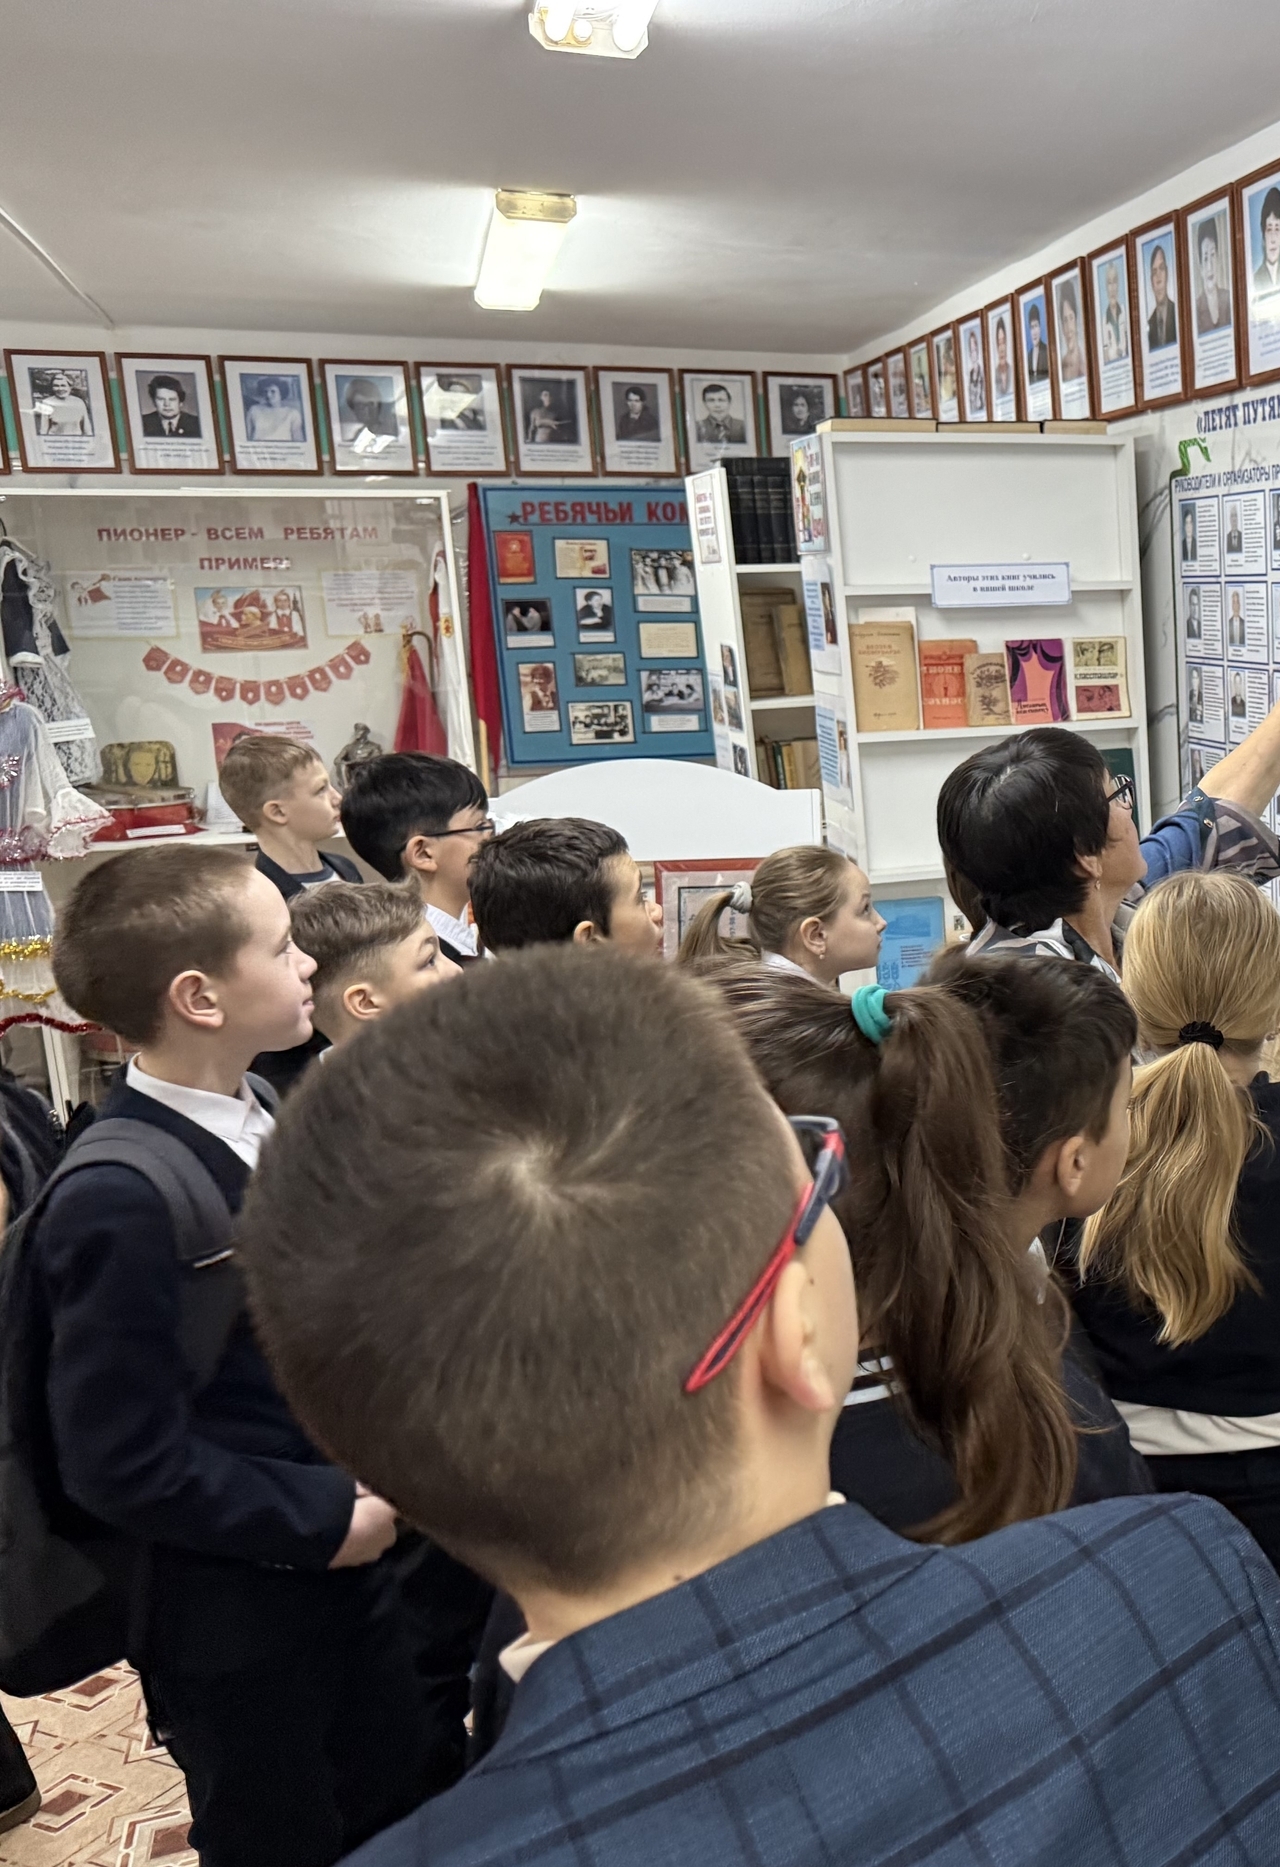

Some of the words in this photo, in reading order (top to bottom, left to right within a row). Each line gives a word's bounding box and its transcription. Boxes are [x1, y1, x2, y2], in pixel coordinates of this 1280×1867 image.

[1174, 475, 1215, 493] РУКОВОДИТЕЛИ
[1223, 465, 1270, 487] ОРГАНИЗАТОРЫ
[521, 502, 633, 523] РЕБЯЧЬИ
[97, 528, 185, 542] ПИОНЕР
[207, 528, 264, 540] ВСЕМ
[284, 526, 378, 540] РЕБЯТАМ
[947, 574, 979, 583] Авторы
[1023, 573, 1056, 582] учились
[980, 584, 1006, 592] нашей
